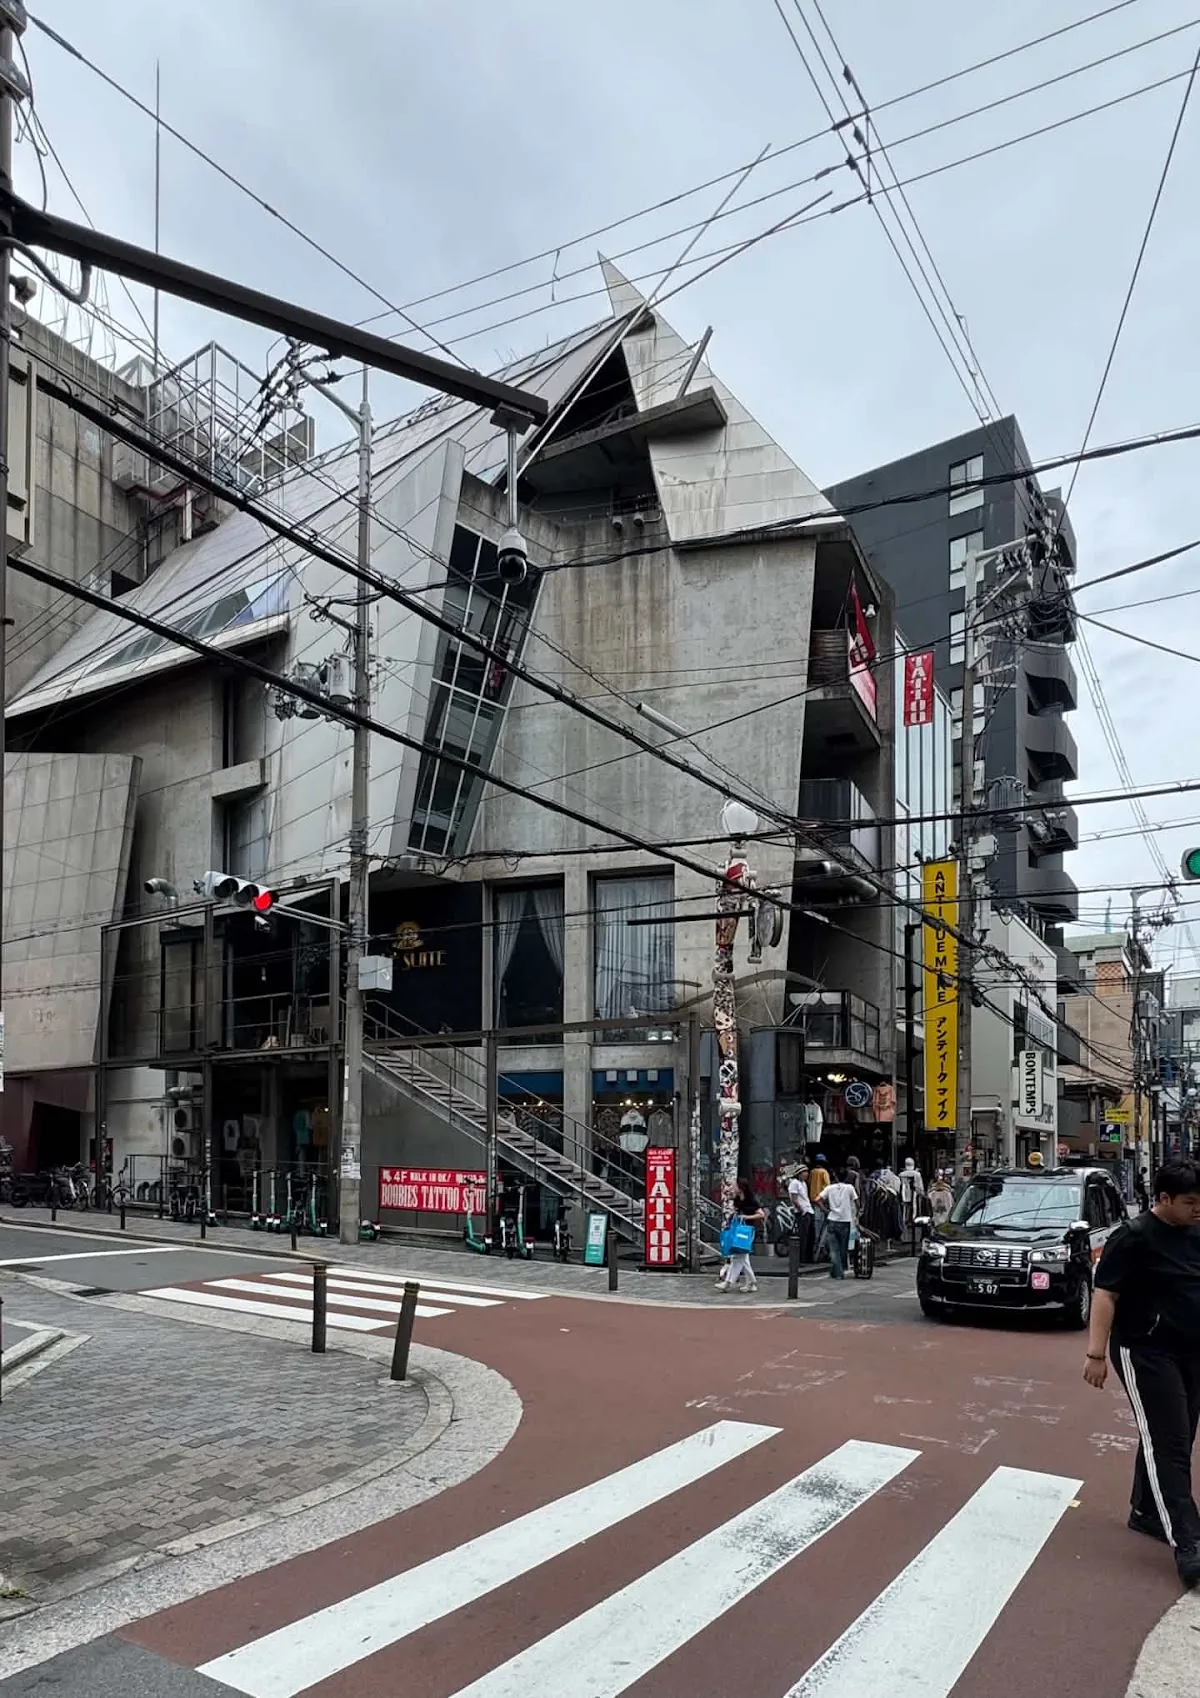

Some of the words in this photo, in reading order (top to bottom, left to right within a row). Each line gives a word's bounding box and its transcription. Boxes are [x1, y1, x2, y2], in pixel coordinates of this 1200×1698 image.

[910, 654, 927, 724] TATTOO
[936, 1017, 948, 1083] アンティーク
[936, 1088, 948, 1121] マイク
[1025, 1052, 1036, 1115] BONTEMPS
[393, 1171, 408, 1183] 4F
[421, 1185, 459, 1211] TATTOO
[649, 1165, 671, 1262] TATTOO
